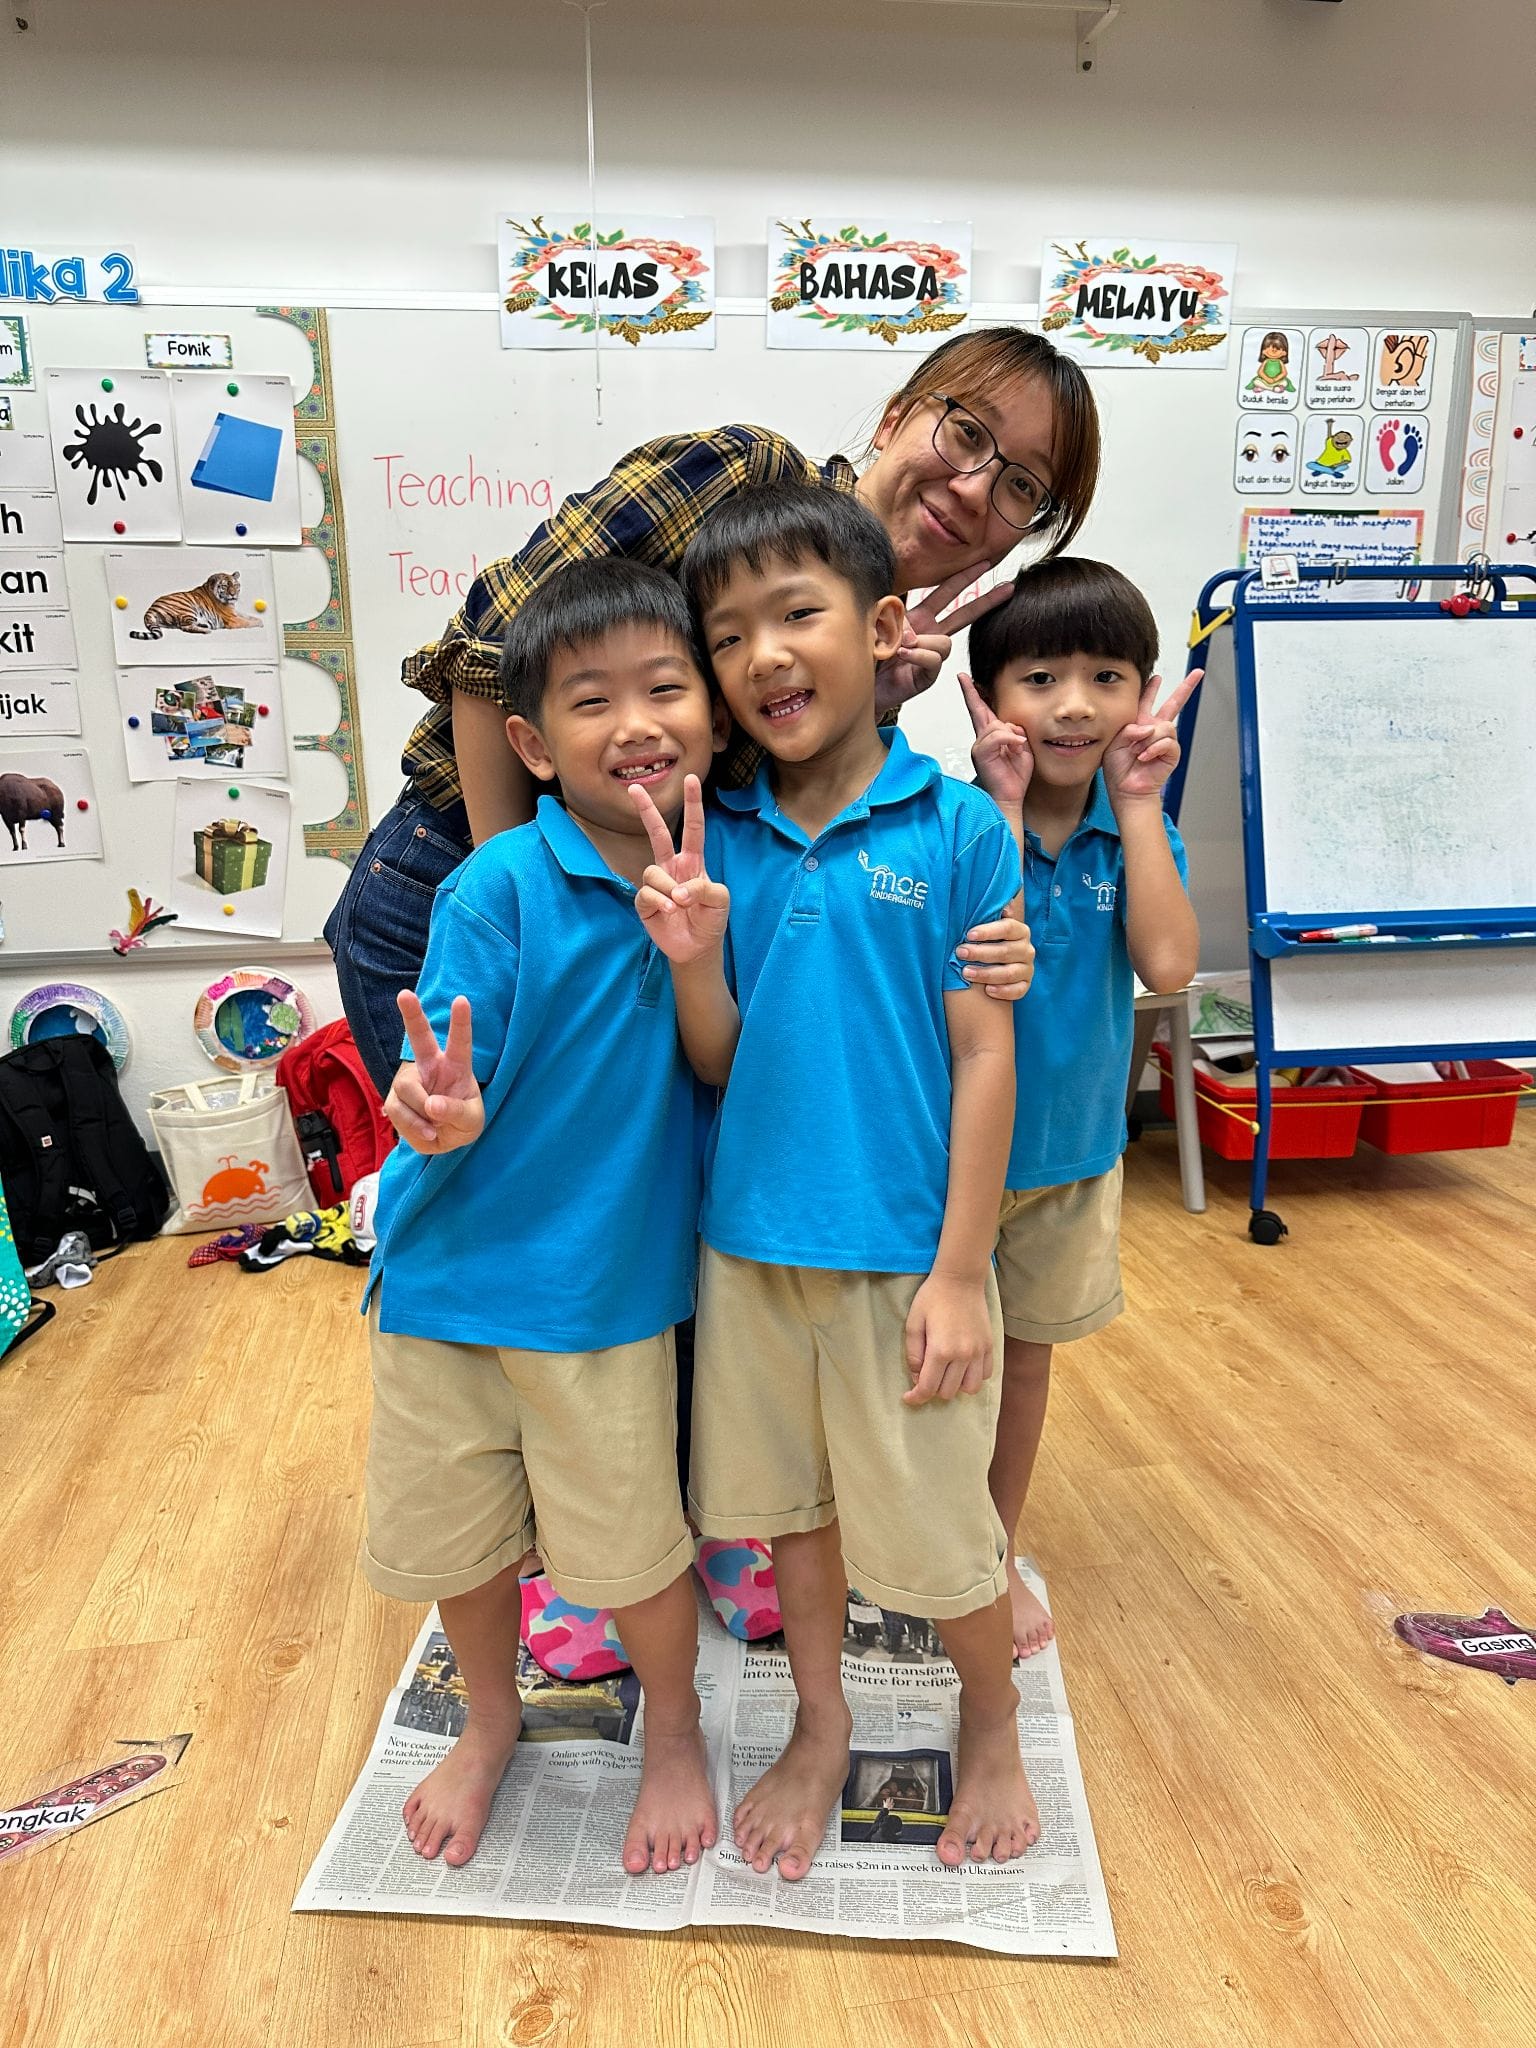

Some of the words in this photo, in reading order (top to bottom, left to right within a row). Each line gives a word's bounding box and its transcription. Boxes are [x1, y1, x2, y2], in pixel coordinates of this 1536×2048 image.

[101, 253, 138, 302] 2
[548, 262, 660, 299] KELAS
[800, 263, 939, 301] BAHASA
[1074, 284, 1199, 321] MELAYU
[168, 340, 211, 358] Fonik
[1242, 394, 1263, 403] Duduk
[373, 454, 554, 518] Teaching
[1304, 480, 1328, 489] Angkat
[1330, 480, 1355, 489] tangan
[1386, 478, 1405, 486] Jalan
[869, 888, 925, 910] KINDERGARTEN
[1462, 1637, 1534, 1653] Gasing
[745, 1657, 786, 1668] Berlin
[743, 1669, 771, 1679] into
[842, 1671, 888, 1686] centre
[892, 1677, 913, 1687] for
[388, 1735, 409, 1748] New
[410, 1742, 436, 1751] codes
[438, 1743, 449, 1751] of
[732, 1743, 773, 1753] Everyone
[775, 1744, 782, 1752] is
[384, 1748, 394, 1756] to
[395, 1749, 422, 1758] tackle
[552, 1750, 580, 1758] Online
[618, 1754, 639, 1763] apps
[742, 1752, 776, 1760] Ukraine
[412, 1758, 436, 1766] child
[549, 1759, 580, 1768] comply
[582, 1757, 601, 1766] with
[825, 1861, 854, 1870] raises
[856, 1861, 879, 1871] $2m
[881, 1862, 891, 1871] in
[902, 1863, 929, 1872] week
[931, 1865, 942, 1873] to
[944, 1865, 966, 1876] help
[968, 1865, 1025, 1876] Ukrainians
